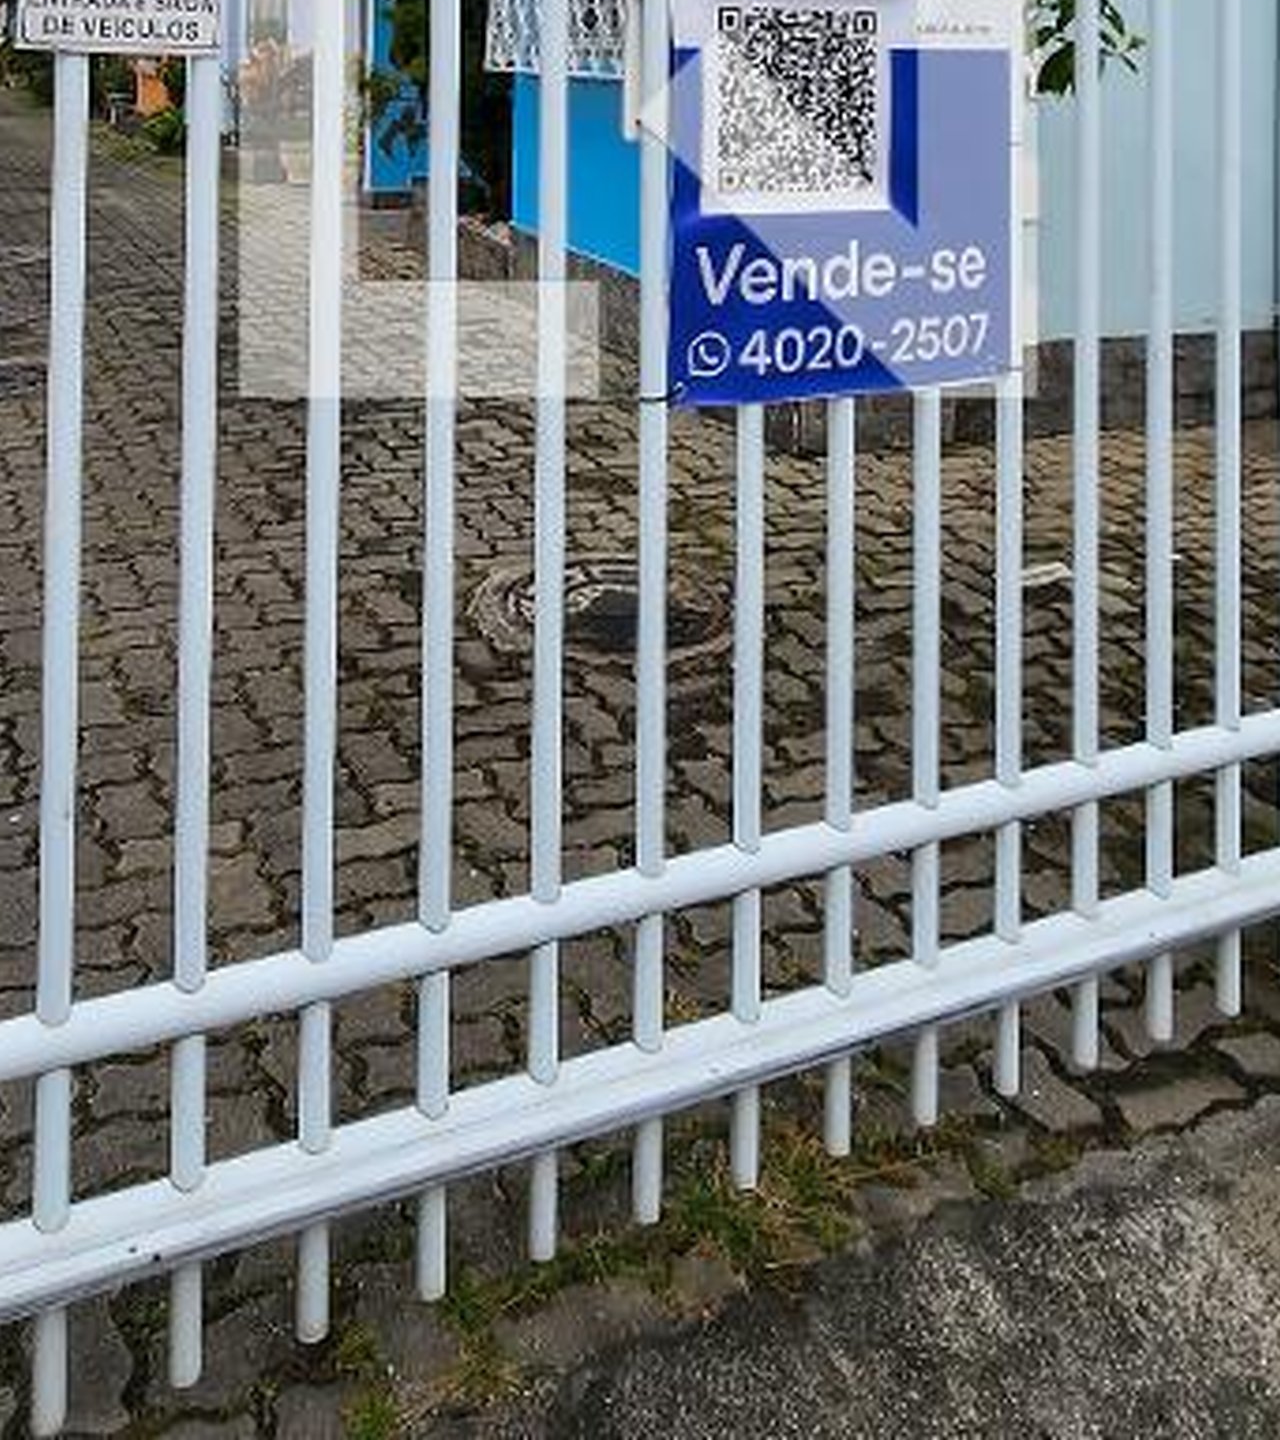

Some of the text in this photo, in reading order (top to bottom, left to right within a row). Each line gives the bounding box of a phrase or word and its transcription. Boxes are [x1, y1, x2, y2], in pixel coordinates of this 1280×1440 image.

[42, 16, 74, 35] DE
[695, 239, 987, 305] Vende-se
[738, 313, 990, 376] 4020-2507
